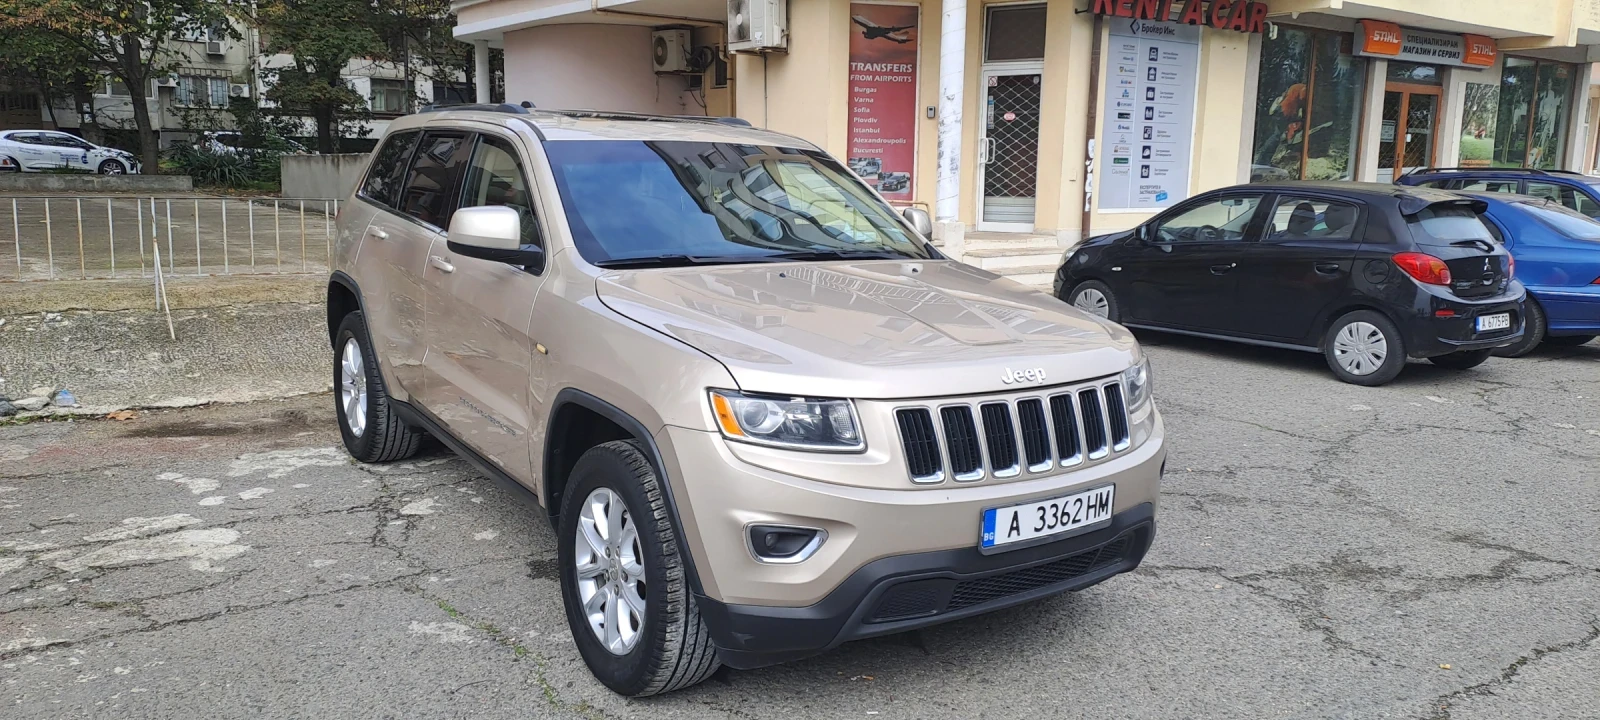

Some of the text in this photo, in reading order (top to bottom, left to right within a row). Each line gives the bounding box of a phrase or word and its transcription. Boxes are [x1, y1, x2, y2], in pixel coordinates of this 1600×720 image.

[1183, 0, 1202, 25] A
[1212, 0, 1267, 33] CAR
[1141, 23, 1176, 36] Брокер Инс
[1372, 30, 1401, 44] STIHL
[1406, 35, 1459, 48] СПЕЦИАЛИЗИРАН
[1402, 45, 1431, 56] МАГАЗИН
[1438, 50, 1460, 59] СЕРВИЗ
[1472, 43, 1497, 56] STIHL
[850, 62, 912, 72] TRANSFERS
[874, 75, 912, 83] AIRPORTS
[854, 86, 877, 94] Burgas
[853, 137, 906, 145] Alexandroupolis
[1001, 367, 1047, 385] Jeep
[1007, 510, 1021, 539] A
[983, 532, 995, 541] BG
